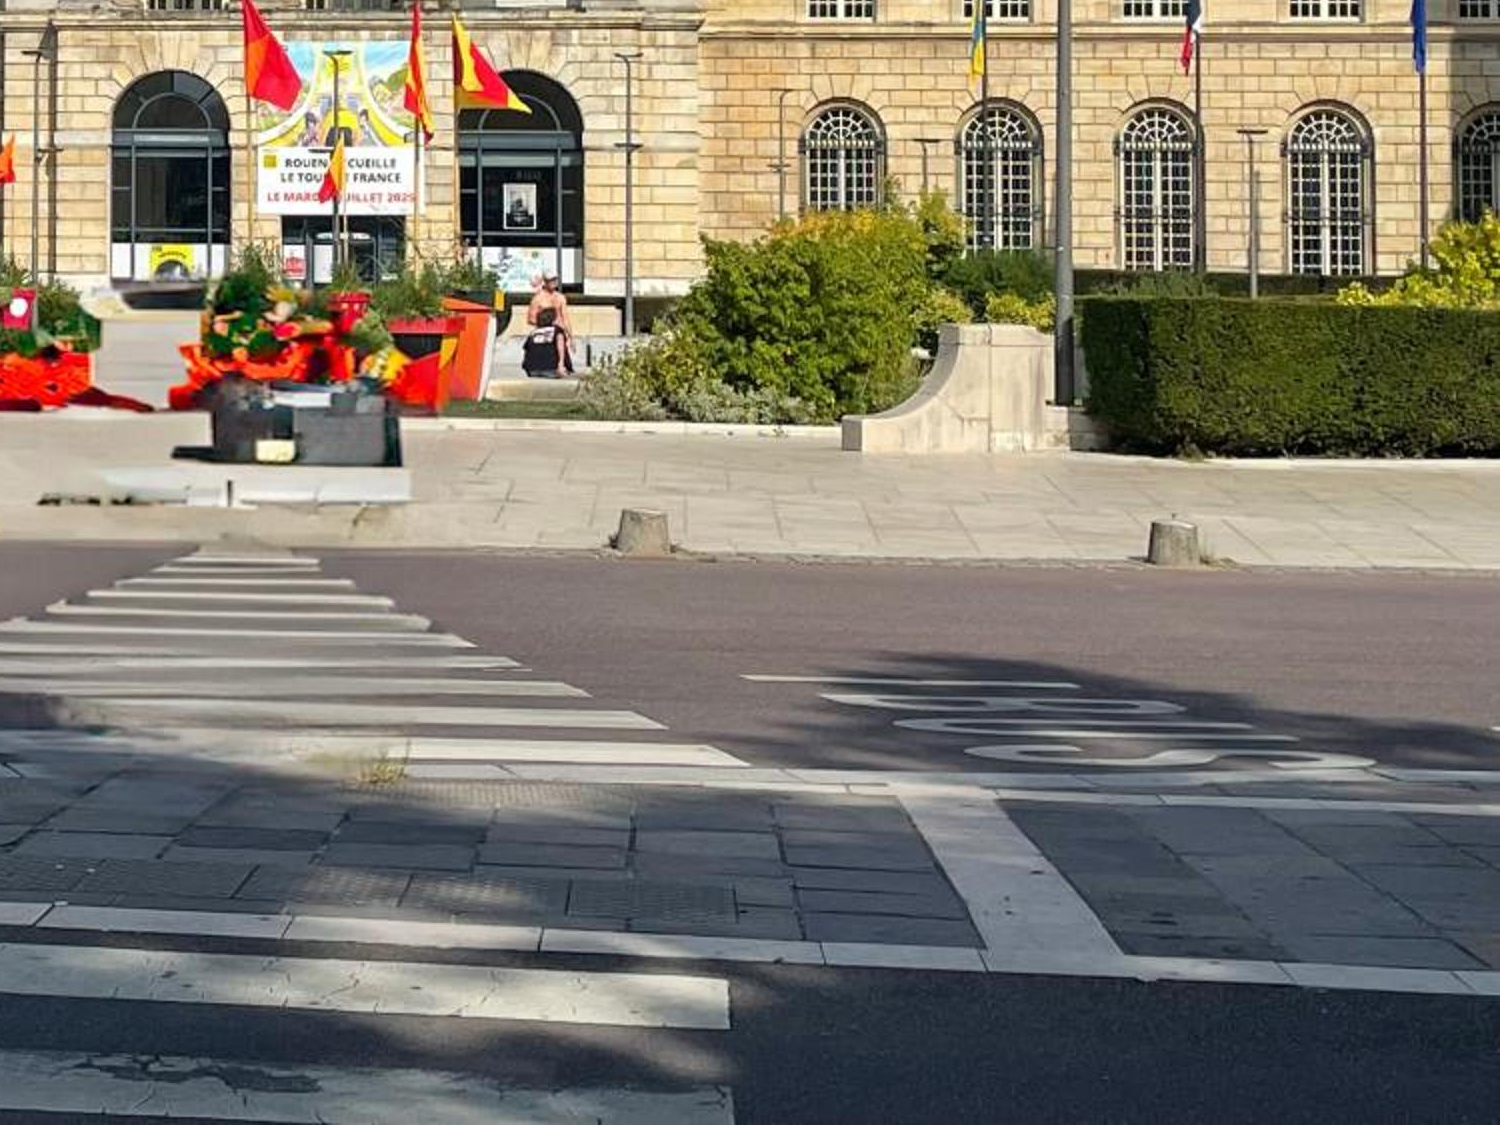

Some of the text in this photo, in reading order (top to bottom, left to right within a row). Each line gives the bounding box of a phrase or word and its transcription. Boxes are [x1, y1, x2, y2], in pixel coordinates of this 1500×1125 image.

[285, 158, 328, 168] ROUEN
[280, 173, 294, 183] LE
[298, 173, 322, 183] TOU
[353, 173, 401, 183] FRANCE
[267, 192, 280, 203] LE
